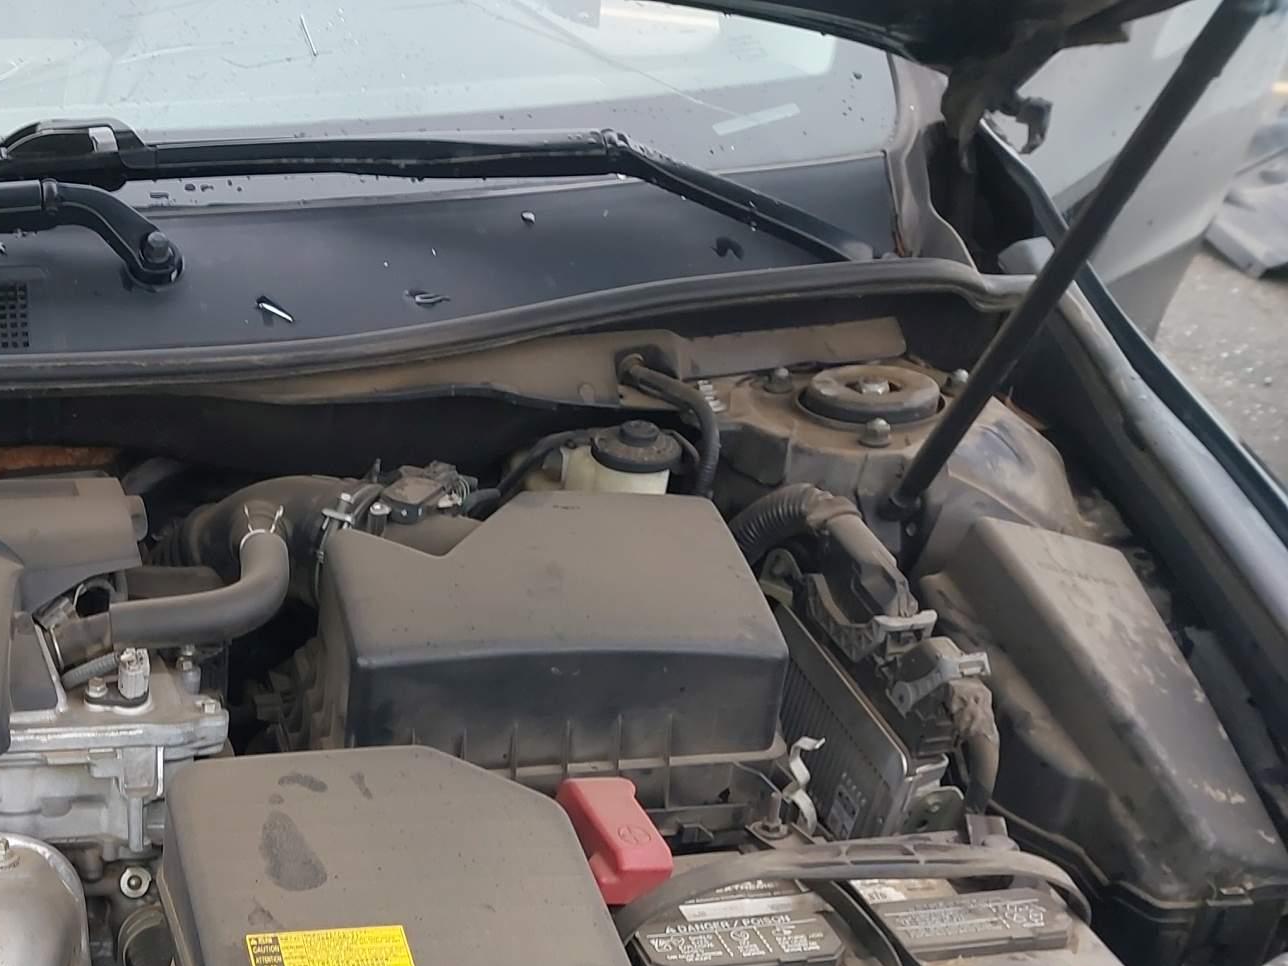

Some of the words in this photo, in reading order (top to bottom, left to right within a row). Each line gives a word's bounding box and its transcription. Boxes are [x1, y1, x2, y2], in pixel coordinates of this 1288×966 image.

[678, 920, 730, 934] DANGER
[742, 914, 792, 928] POISON
[252, 945, 280, 954] CAUTION
